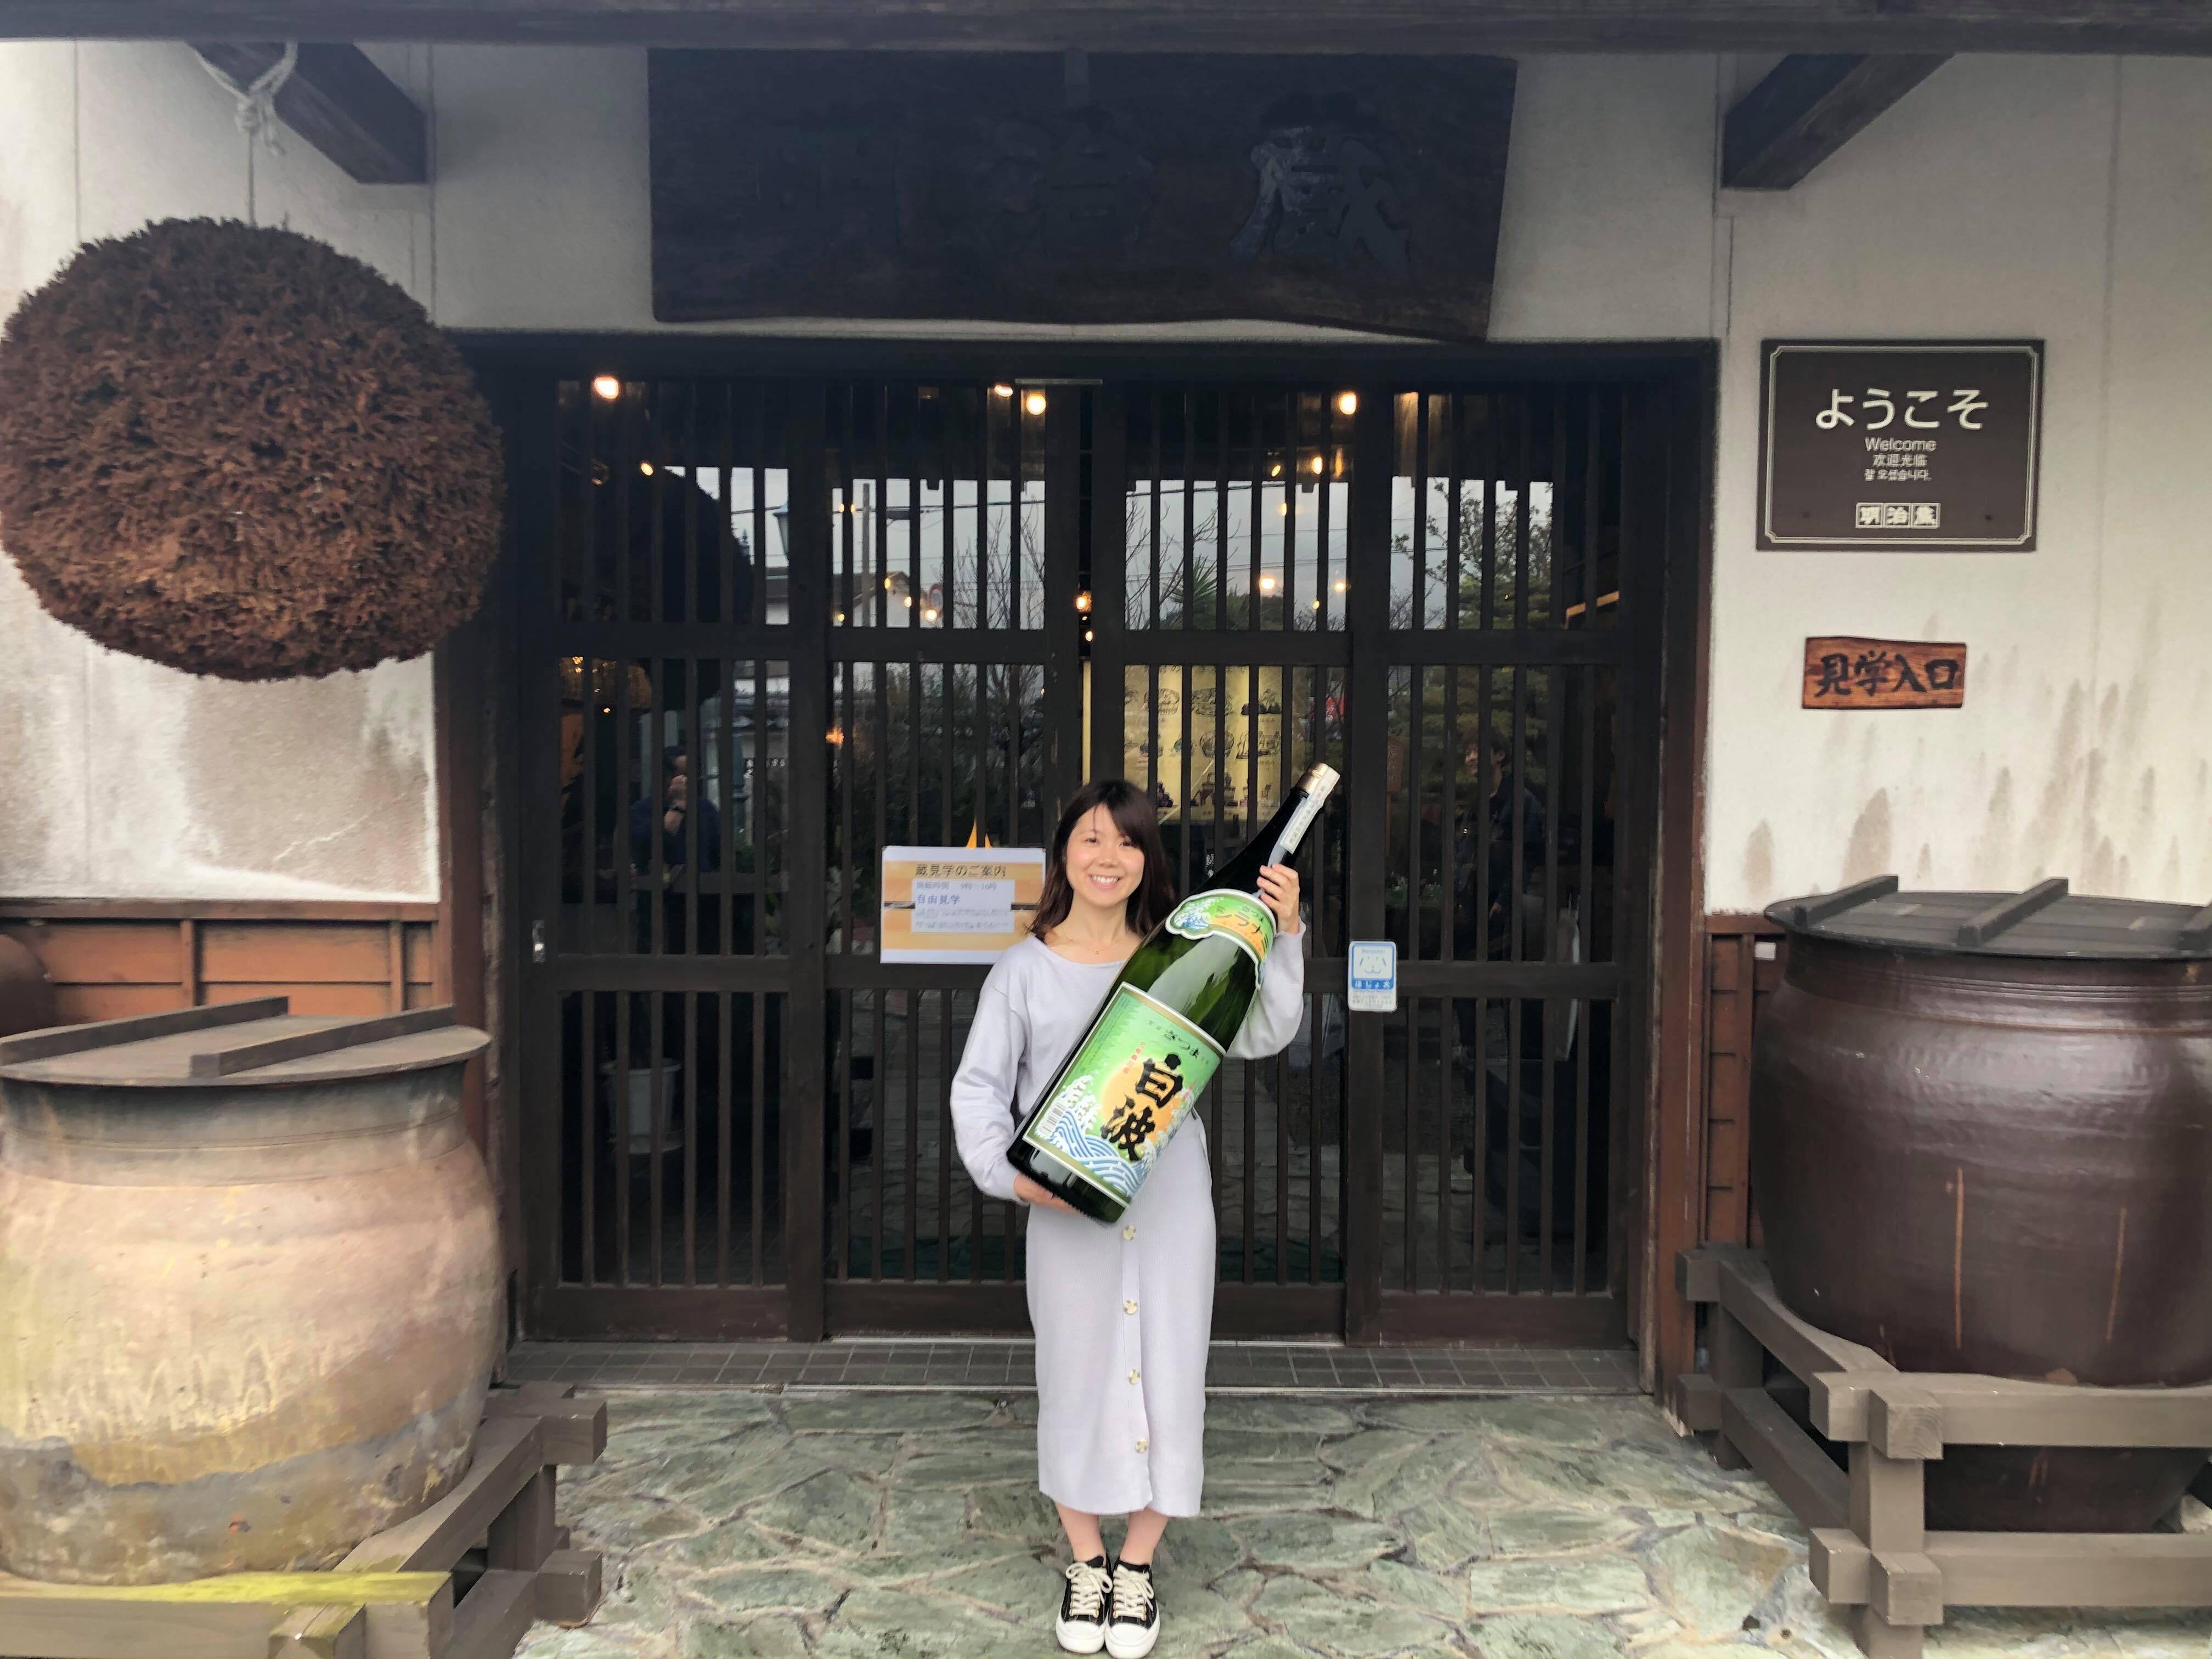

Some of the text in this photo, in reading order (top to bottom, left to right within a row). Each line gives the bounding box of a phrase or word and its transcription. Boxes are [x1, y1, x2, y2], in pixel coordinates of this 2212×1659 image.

[1815, 387, 1989, 431] ようこそ
[1865, 437, 1937, 452] Welcome
[1814, 649, 1959, 697] 見学入口
[915, 864, 1006, 878] 蔵見学のご案内
[917, 894, 961, 905] 自由見学
[1163, 1029, 1200, 1058] さつま
[1100, 1053, 1184, 1161] 白波
